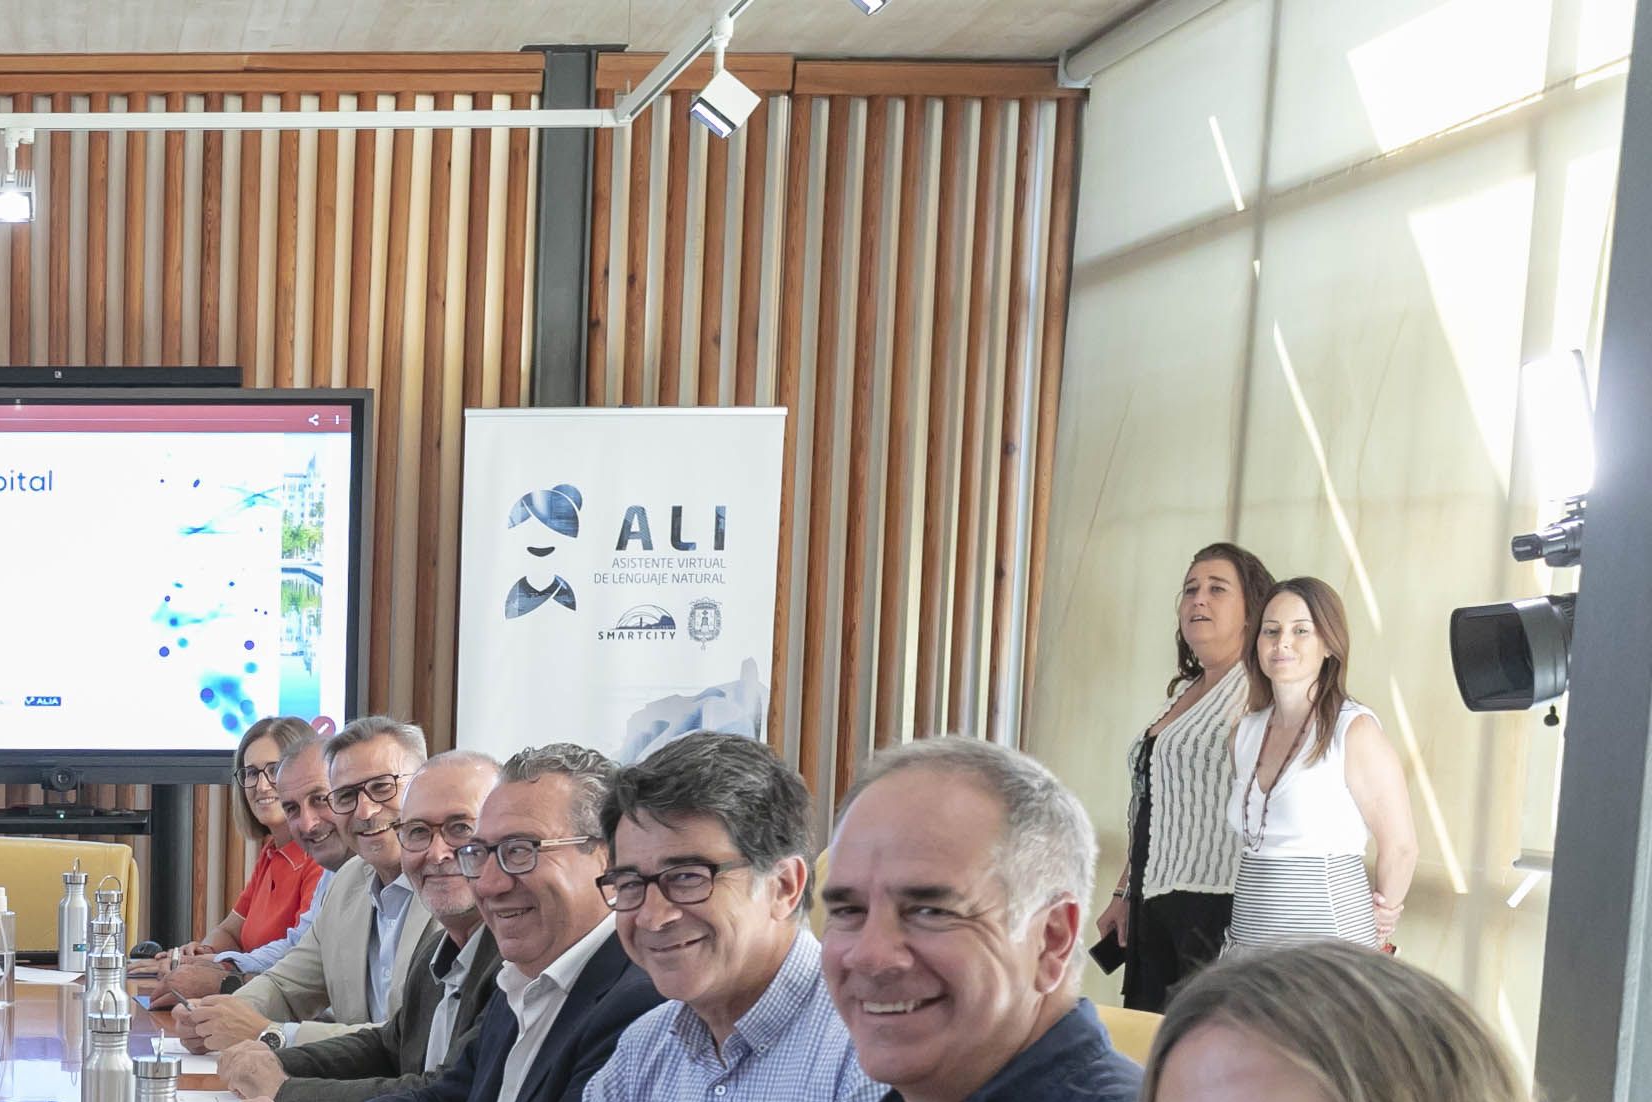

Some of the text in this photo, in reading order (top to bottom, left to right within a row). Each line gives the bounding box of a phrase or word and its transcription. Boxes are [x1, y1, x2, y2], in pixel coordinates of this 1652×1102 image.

[615, 505, 726, 551] ALI
[611, 557, 727, 569] ASISTENTE VIRTUAL
[594, 573, 726, 586] DE LENGUAJE NATURAL
